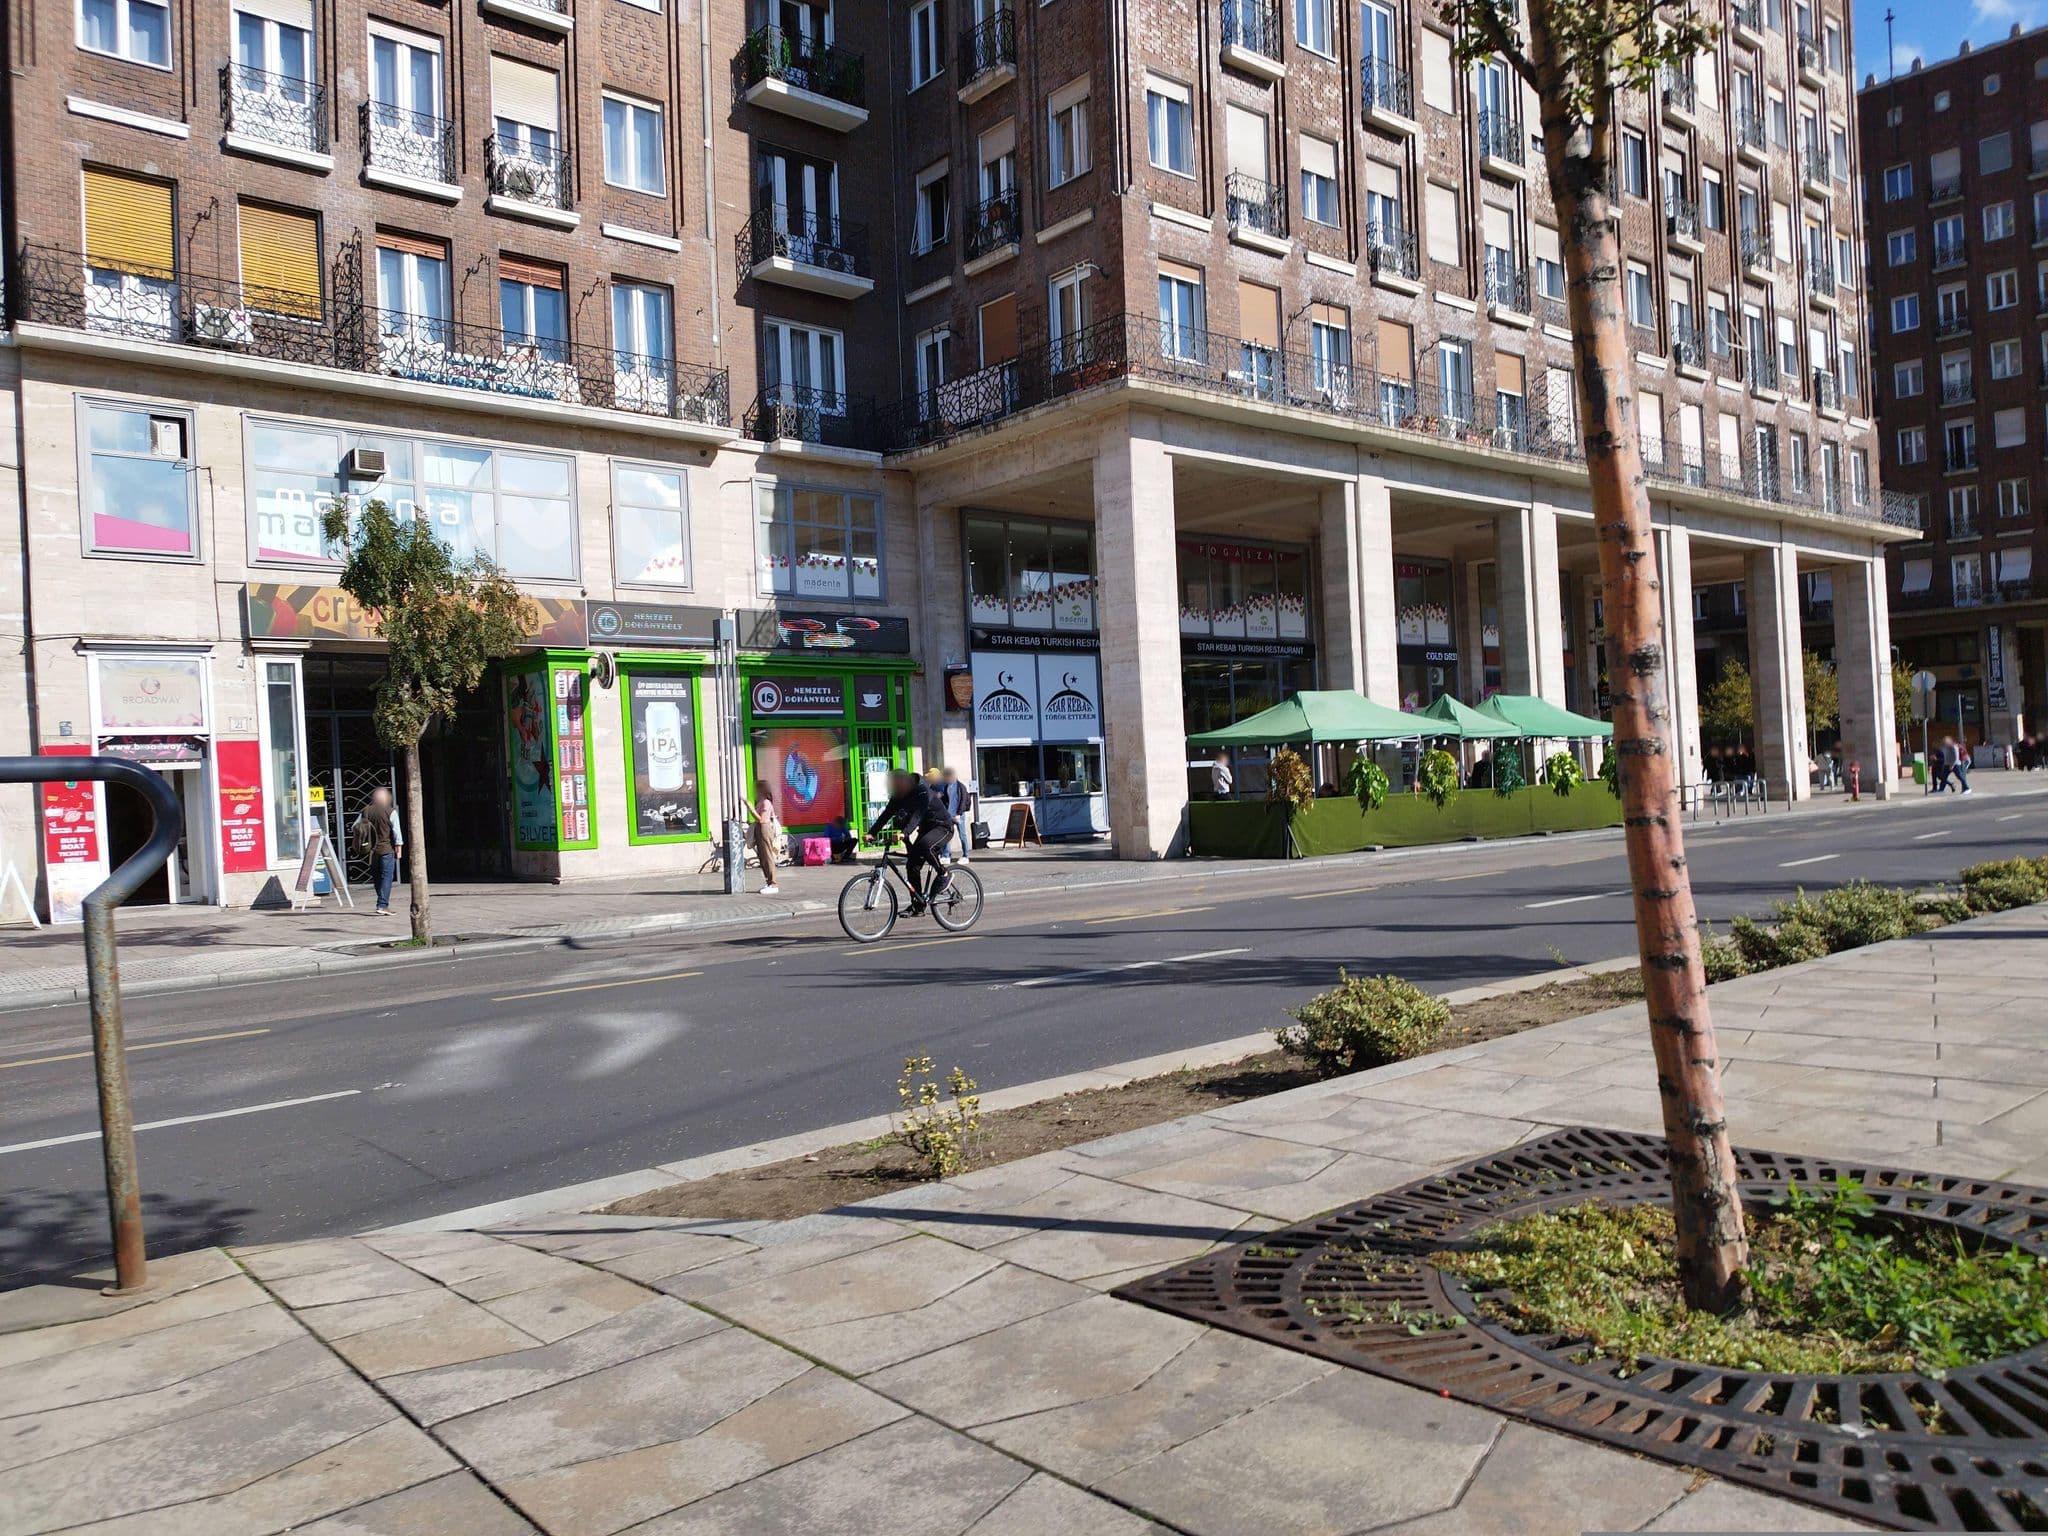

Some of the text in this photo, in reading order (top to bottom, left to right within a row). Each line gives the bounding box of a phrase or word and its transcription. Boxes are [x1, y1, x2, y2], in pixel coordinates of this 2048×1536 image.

[803, 578, 841, 588] madenta
[633, 612, 673, 621] NEMZETI
[991, 635, 1013, 645] STAR
[1014, 636, 1041, 646] KEBAB
[1041, 637, 1075, 647] TURKISH
[1197, 643, 1305, 655] STAR KEBAB TURKISH RESTAURANT
[122, 696, 181, 705] BROADWAY
[760, 692, 776, 703] 18
[784, 694, 841, 704] DOHÁNYBOLT
[981, 696, 1029, 713] STAR KEBAB
[1047, 696, 1093, 713] STAR KEBAB
[651, 737, 678, 753] IPA
